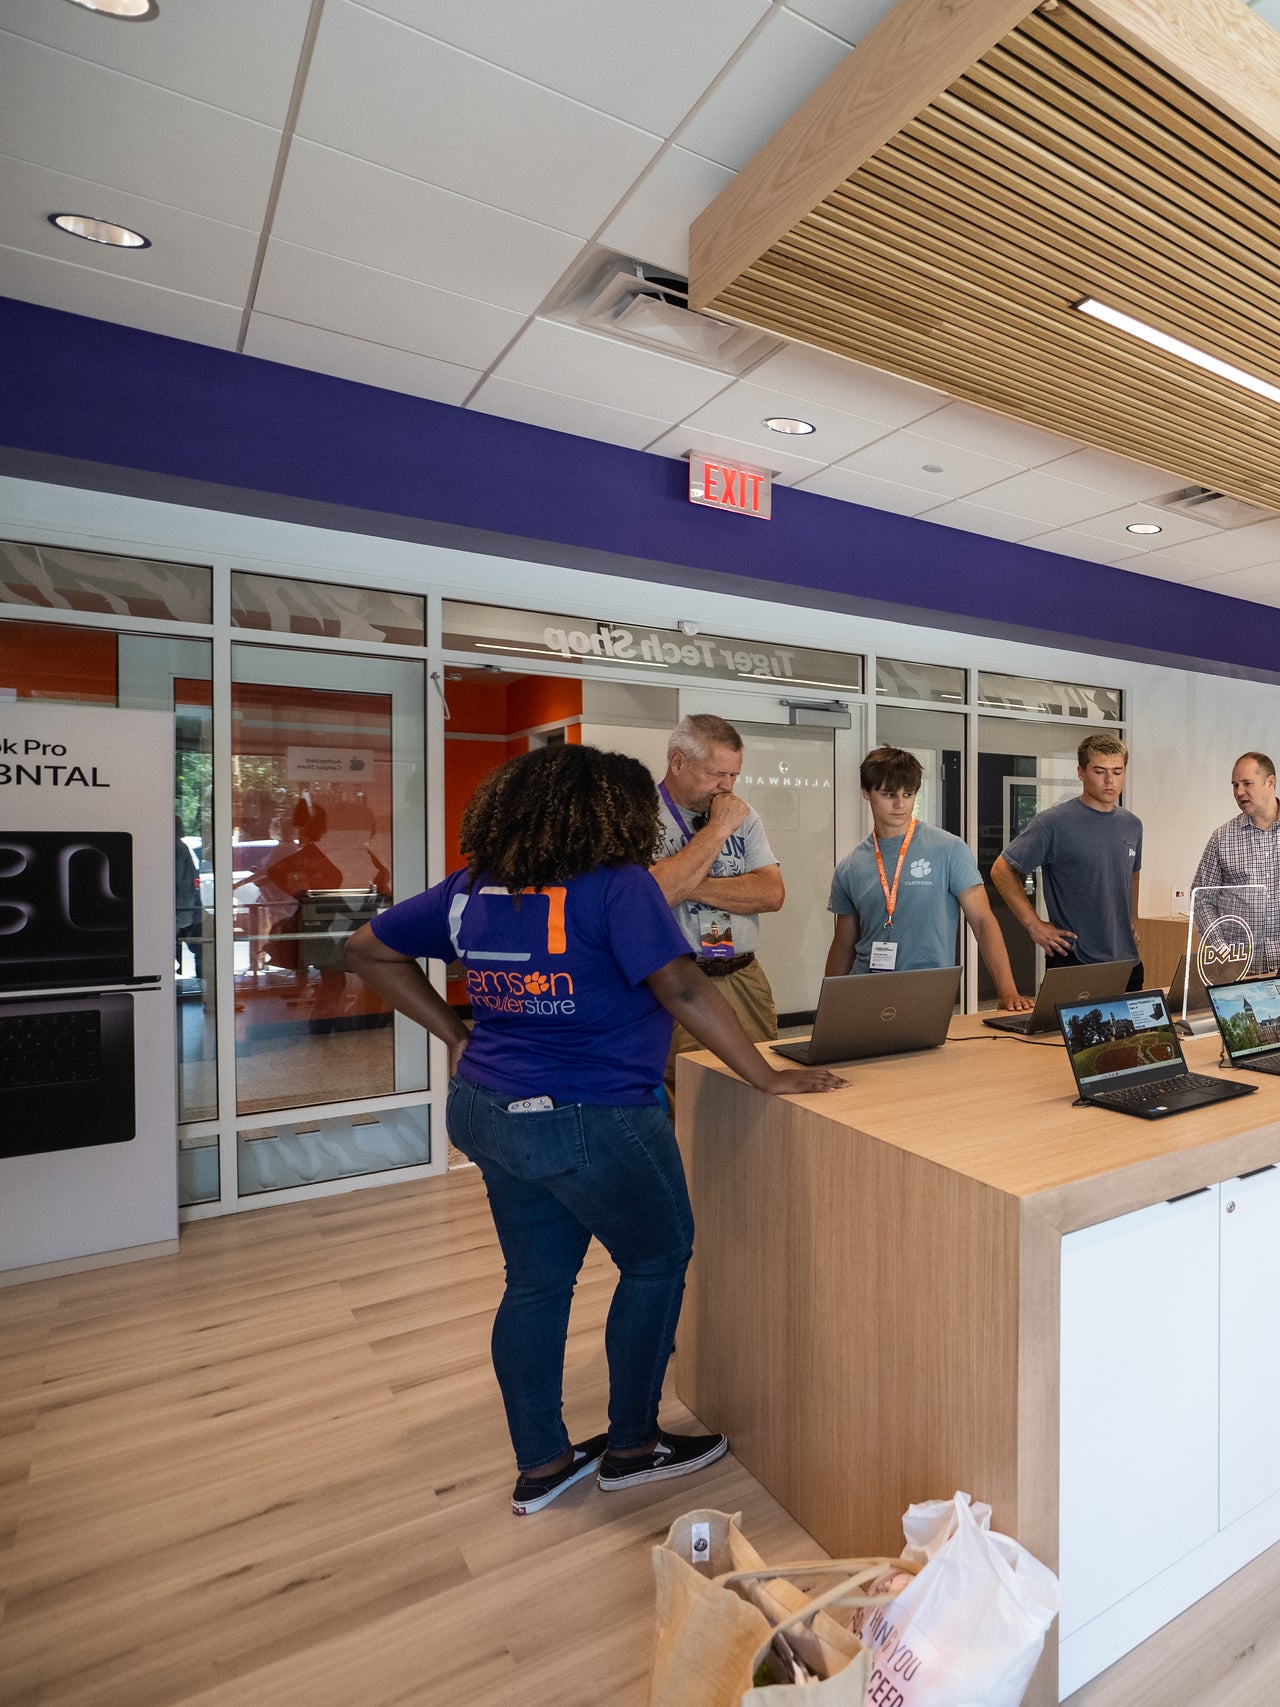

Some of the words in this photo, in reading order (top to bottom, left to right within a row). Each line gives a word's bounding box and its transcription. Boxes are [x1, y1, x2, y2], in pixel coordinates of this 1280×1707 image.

[703, 462, 765, 512] EXIT
[24, 739, 67, 756] Pro
[1204, 943, 1248, 964] DELL
[466, 992, 576, 1015] mputerstore
[887, 1640, 923, 1682] YOU
